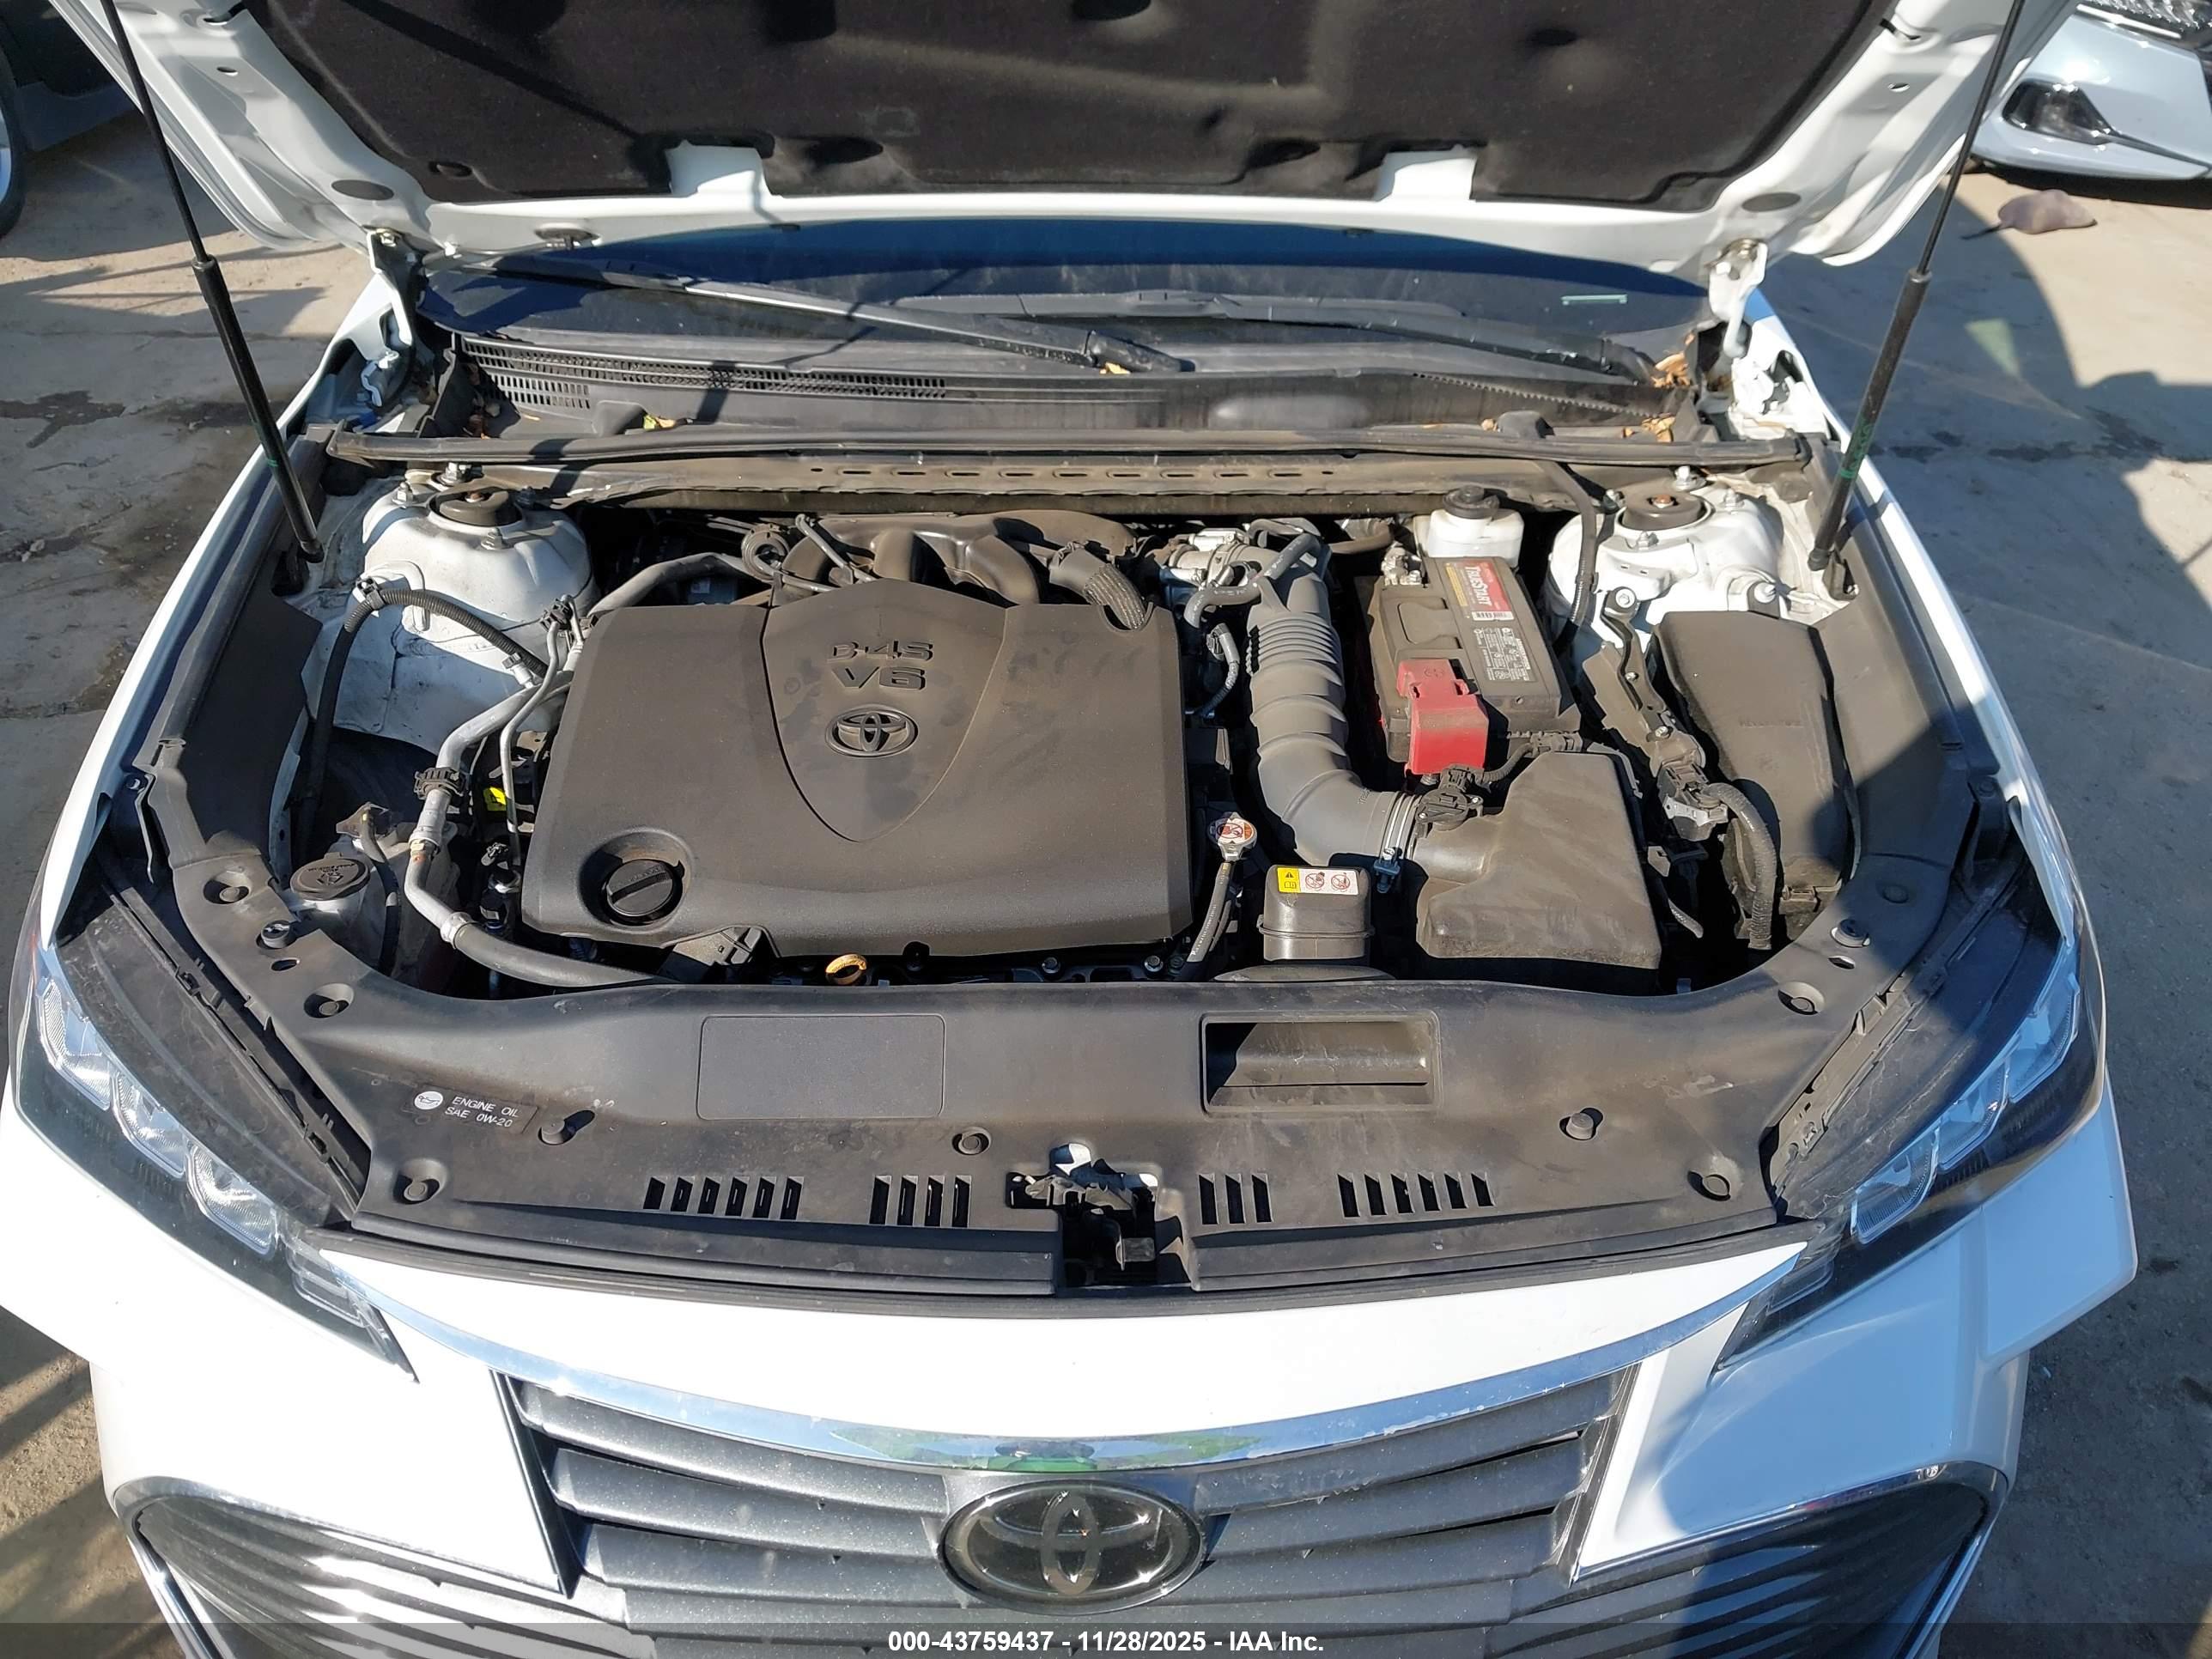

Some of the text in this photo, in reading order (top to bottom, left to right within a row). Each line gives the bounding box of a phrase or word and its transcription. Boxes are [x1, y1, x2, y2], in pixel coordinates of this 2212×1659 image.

[831, 665, 926, 690] V6
[445, 1106, 514, 1127] SAE 0W-20
[452, 1096, 520, 1118] ENGINE OIL
